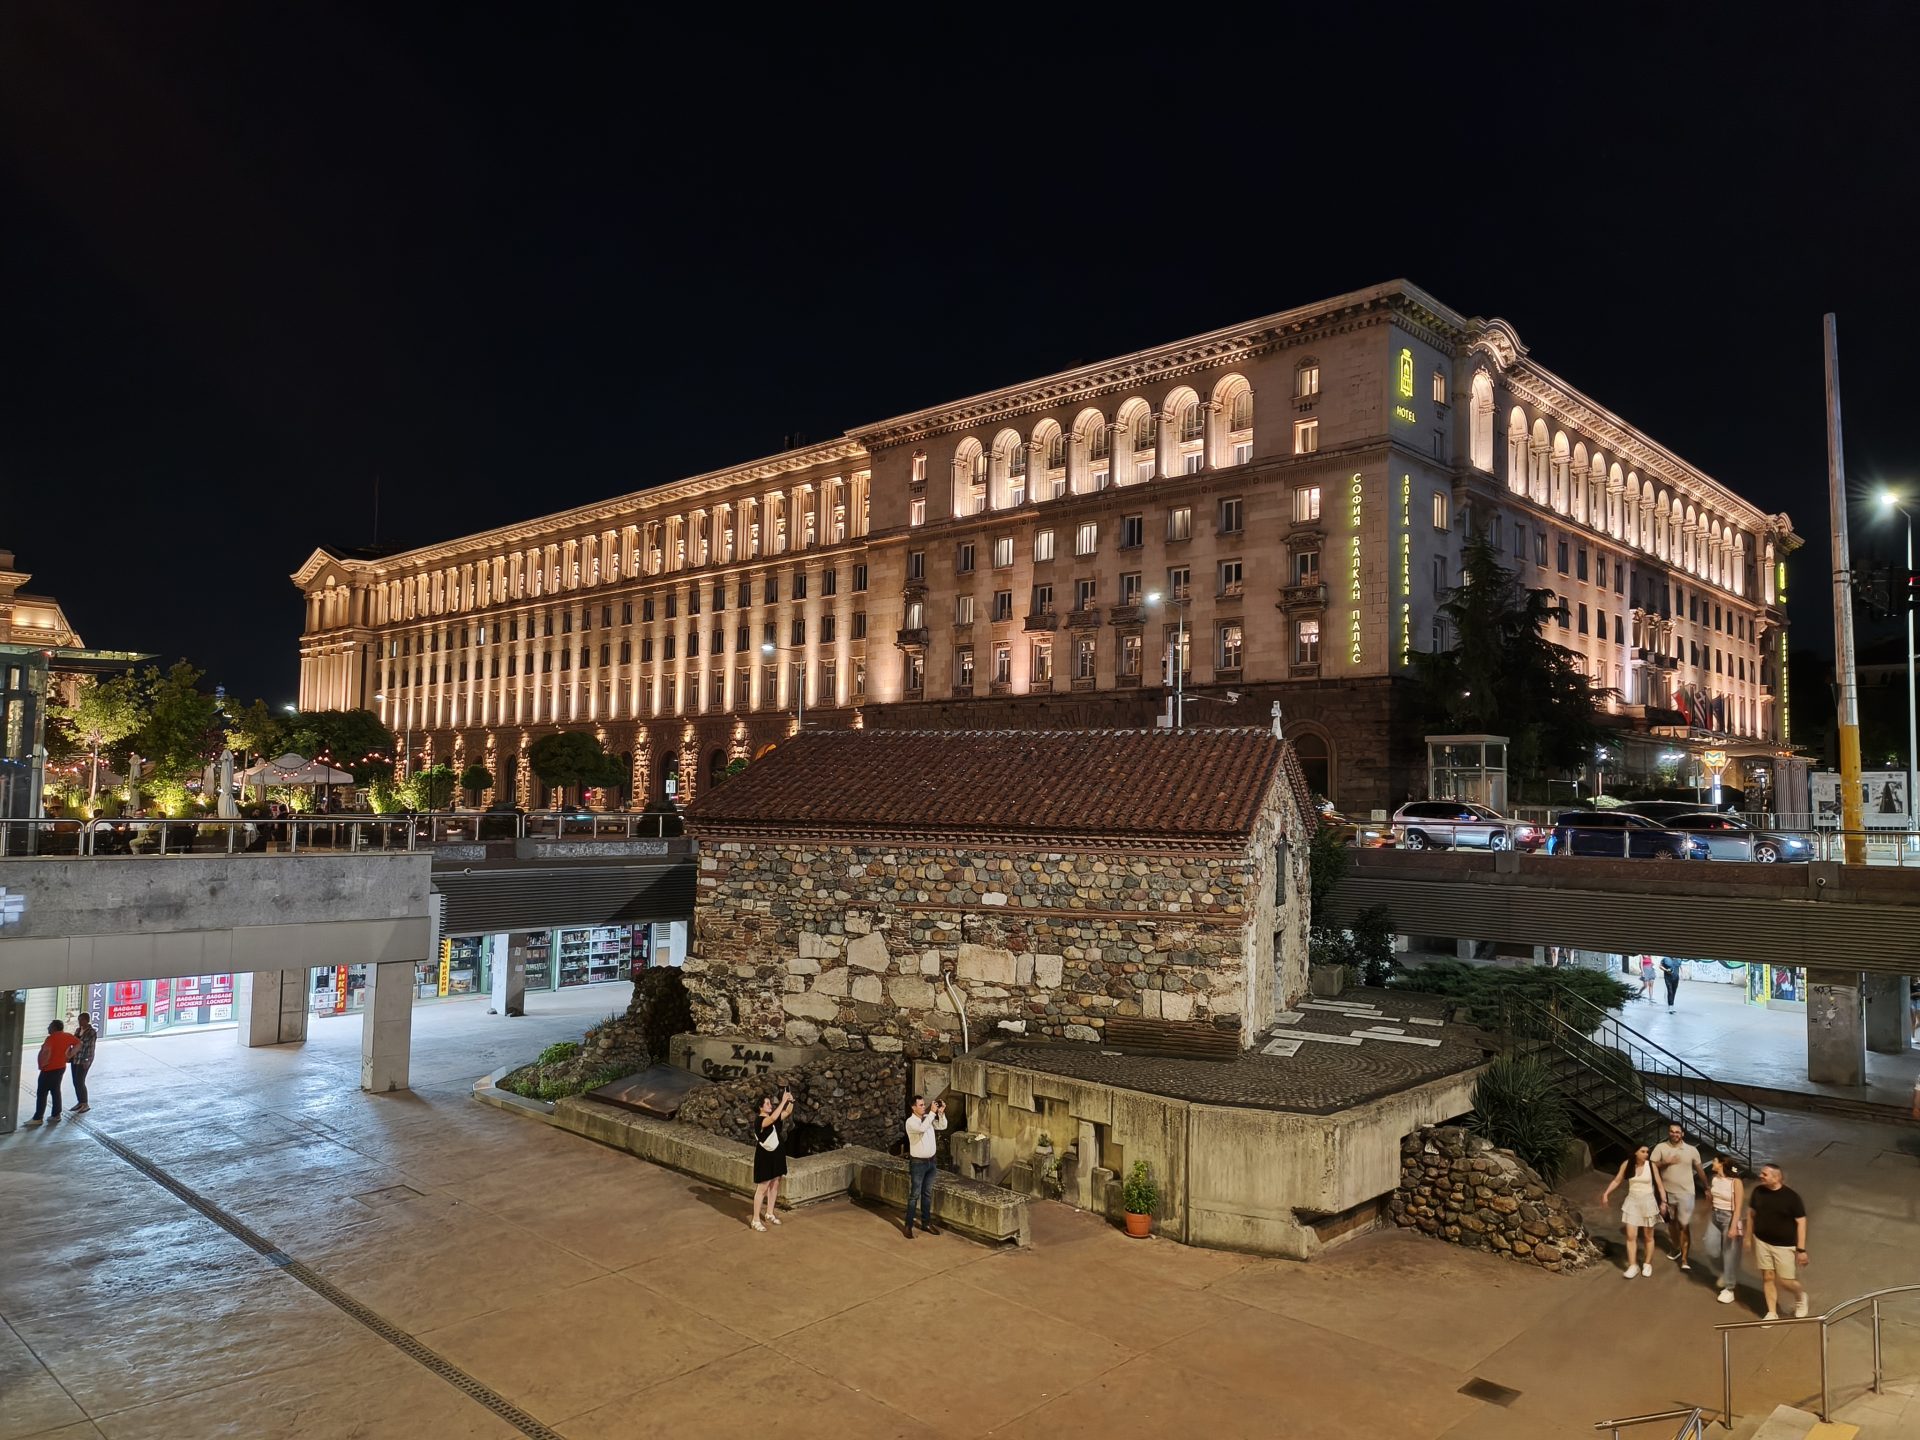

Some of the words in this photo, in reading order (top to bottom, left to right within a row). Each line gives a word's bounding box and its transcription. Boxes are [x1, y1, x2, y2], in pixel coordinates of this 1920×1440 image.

[1396, 405, 1416, 423] HOTEL
[1352, 473, 1362, 526] СОФИЯ
[1352, 536, 1361, 600] БАЛКАН
[1352, 609, 1361, 663] ПАЛАС
[176, 1000, 203, 1008] LOCKERS
[206, 992, 232, 1000] BAGGAGE
[91, 983, 102, 1032] KERS
[113, 1004, 143, 1012] BAGGAGE
[731, 1044, 774, 1065] Храм
